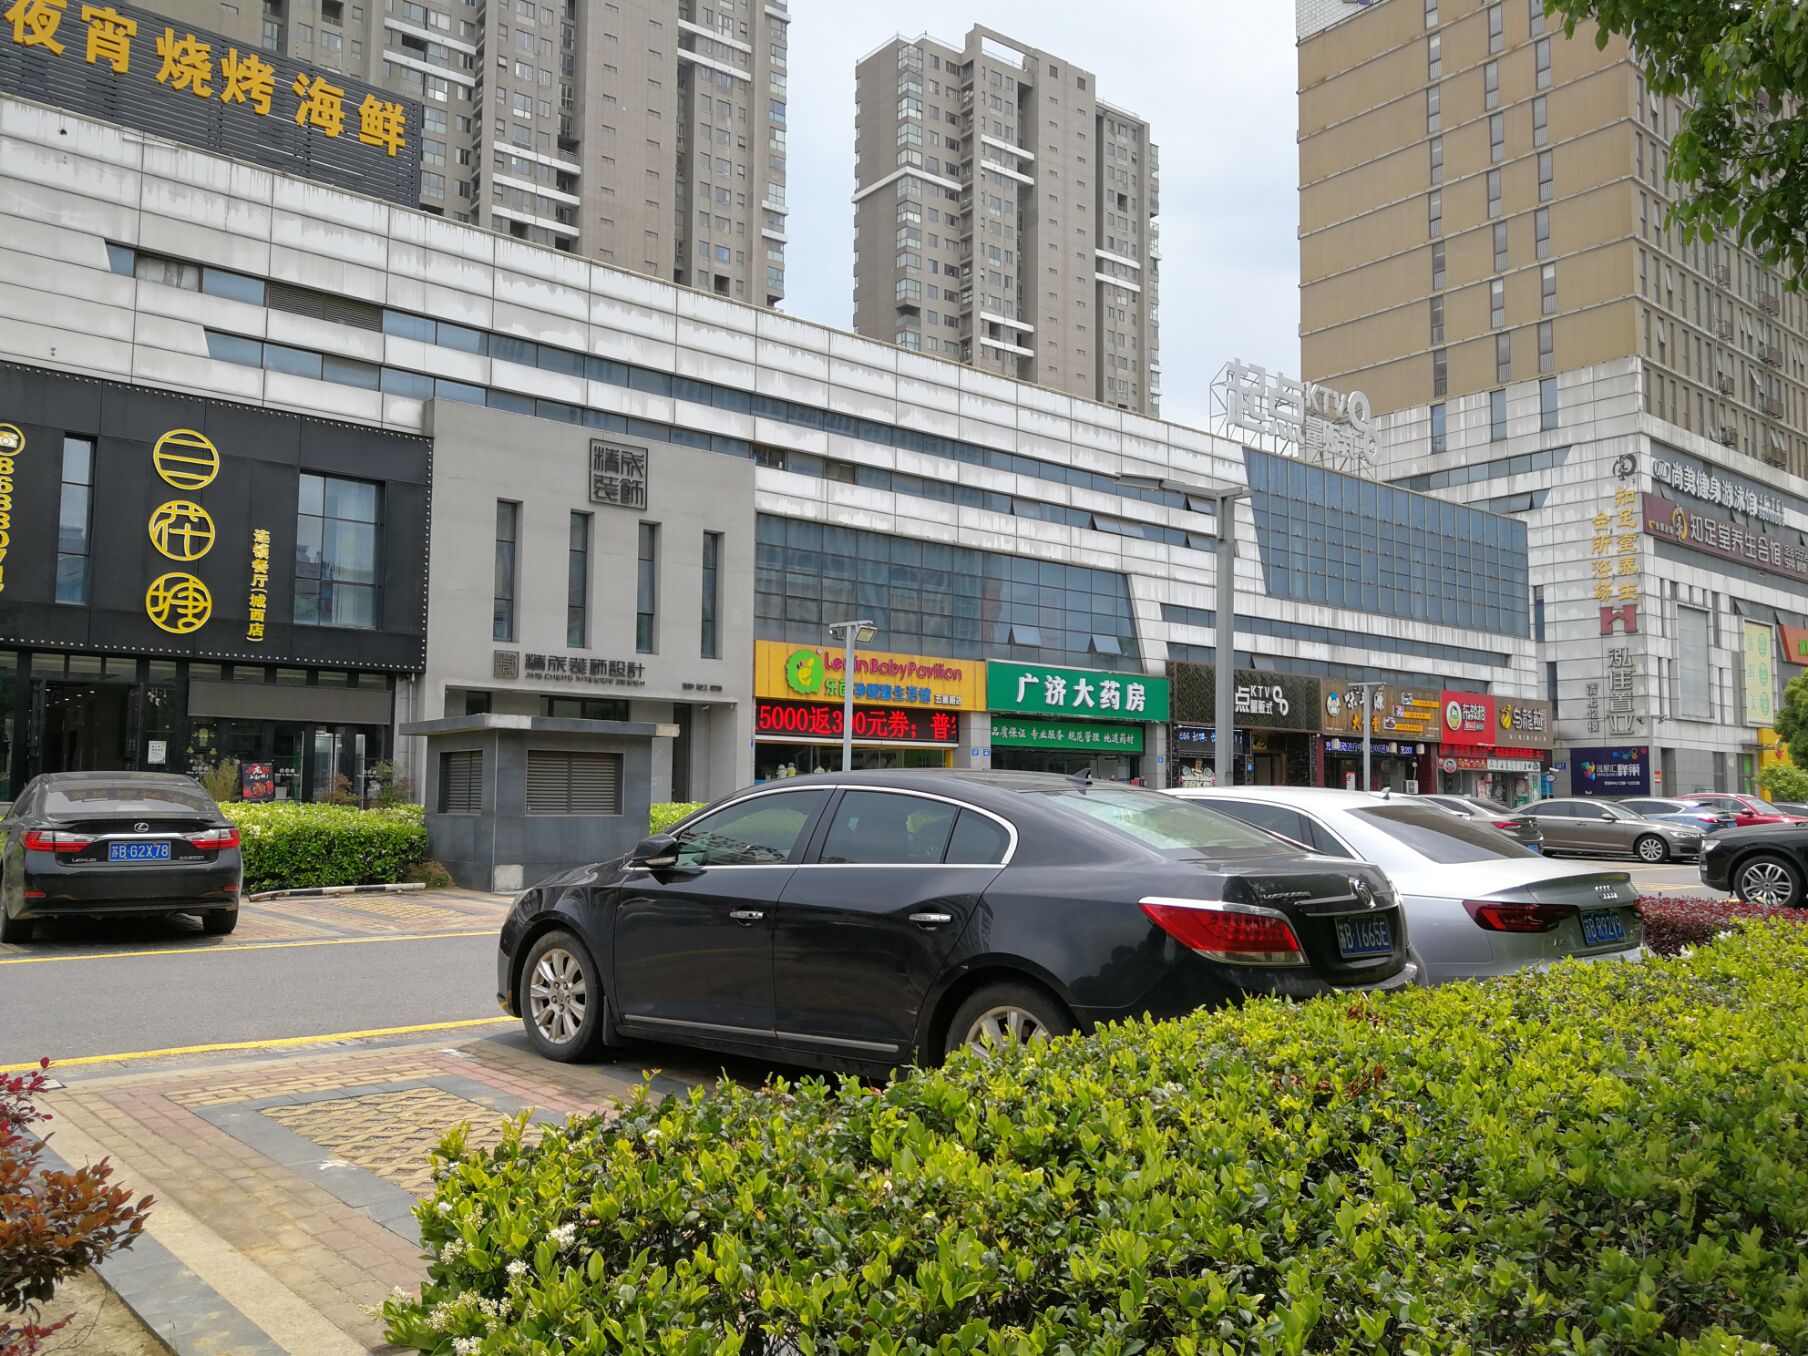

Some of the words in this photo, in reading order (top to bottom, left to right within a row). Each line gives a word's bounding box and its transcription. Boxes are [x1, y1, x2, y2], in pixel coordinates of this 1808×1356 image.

[4, 0, 407, 157] 夜宵烧烤海鲜
[1306, 381, 1347, 417] KTV
[1615, 486, 1640, 601] 知足堂养生
[1690, 512, 1782, 567] 知足堂养生会馆
[824, 652, 869, 673] Lein
[871, 657, 907, 681] Baby
[908, 661, 962, 682] Pavilion
[1016, 672, 1147, 712] 广济大药房
[1250, 684, 1271, 699] KTV
[755, 706, 917, 738] 5000返30元券；
[992, 726, 1026, 739] 品质保证
[1030, 727, 1065, 740] 专业服务
[1068, 730, 1100, 743] 规范管理
